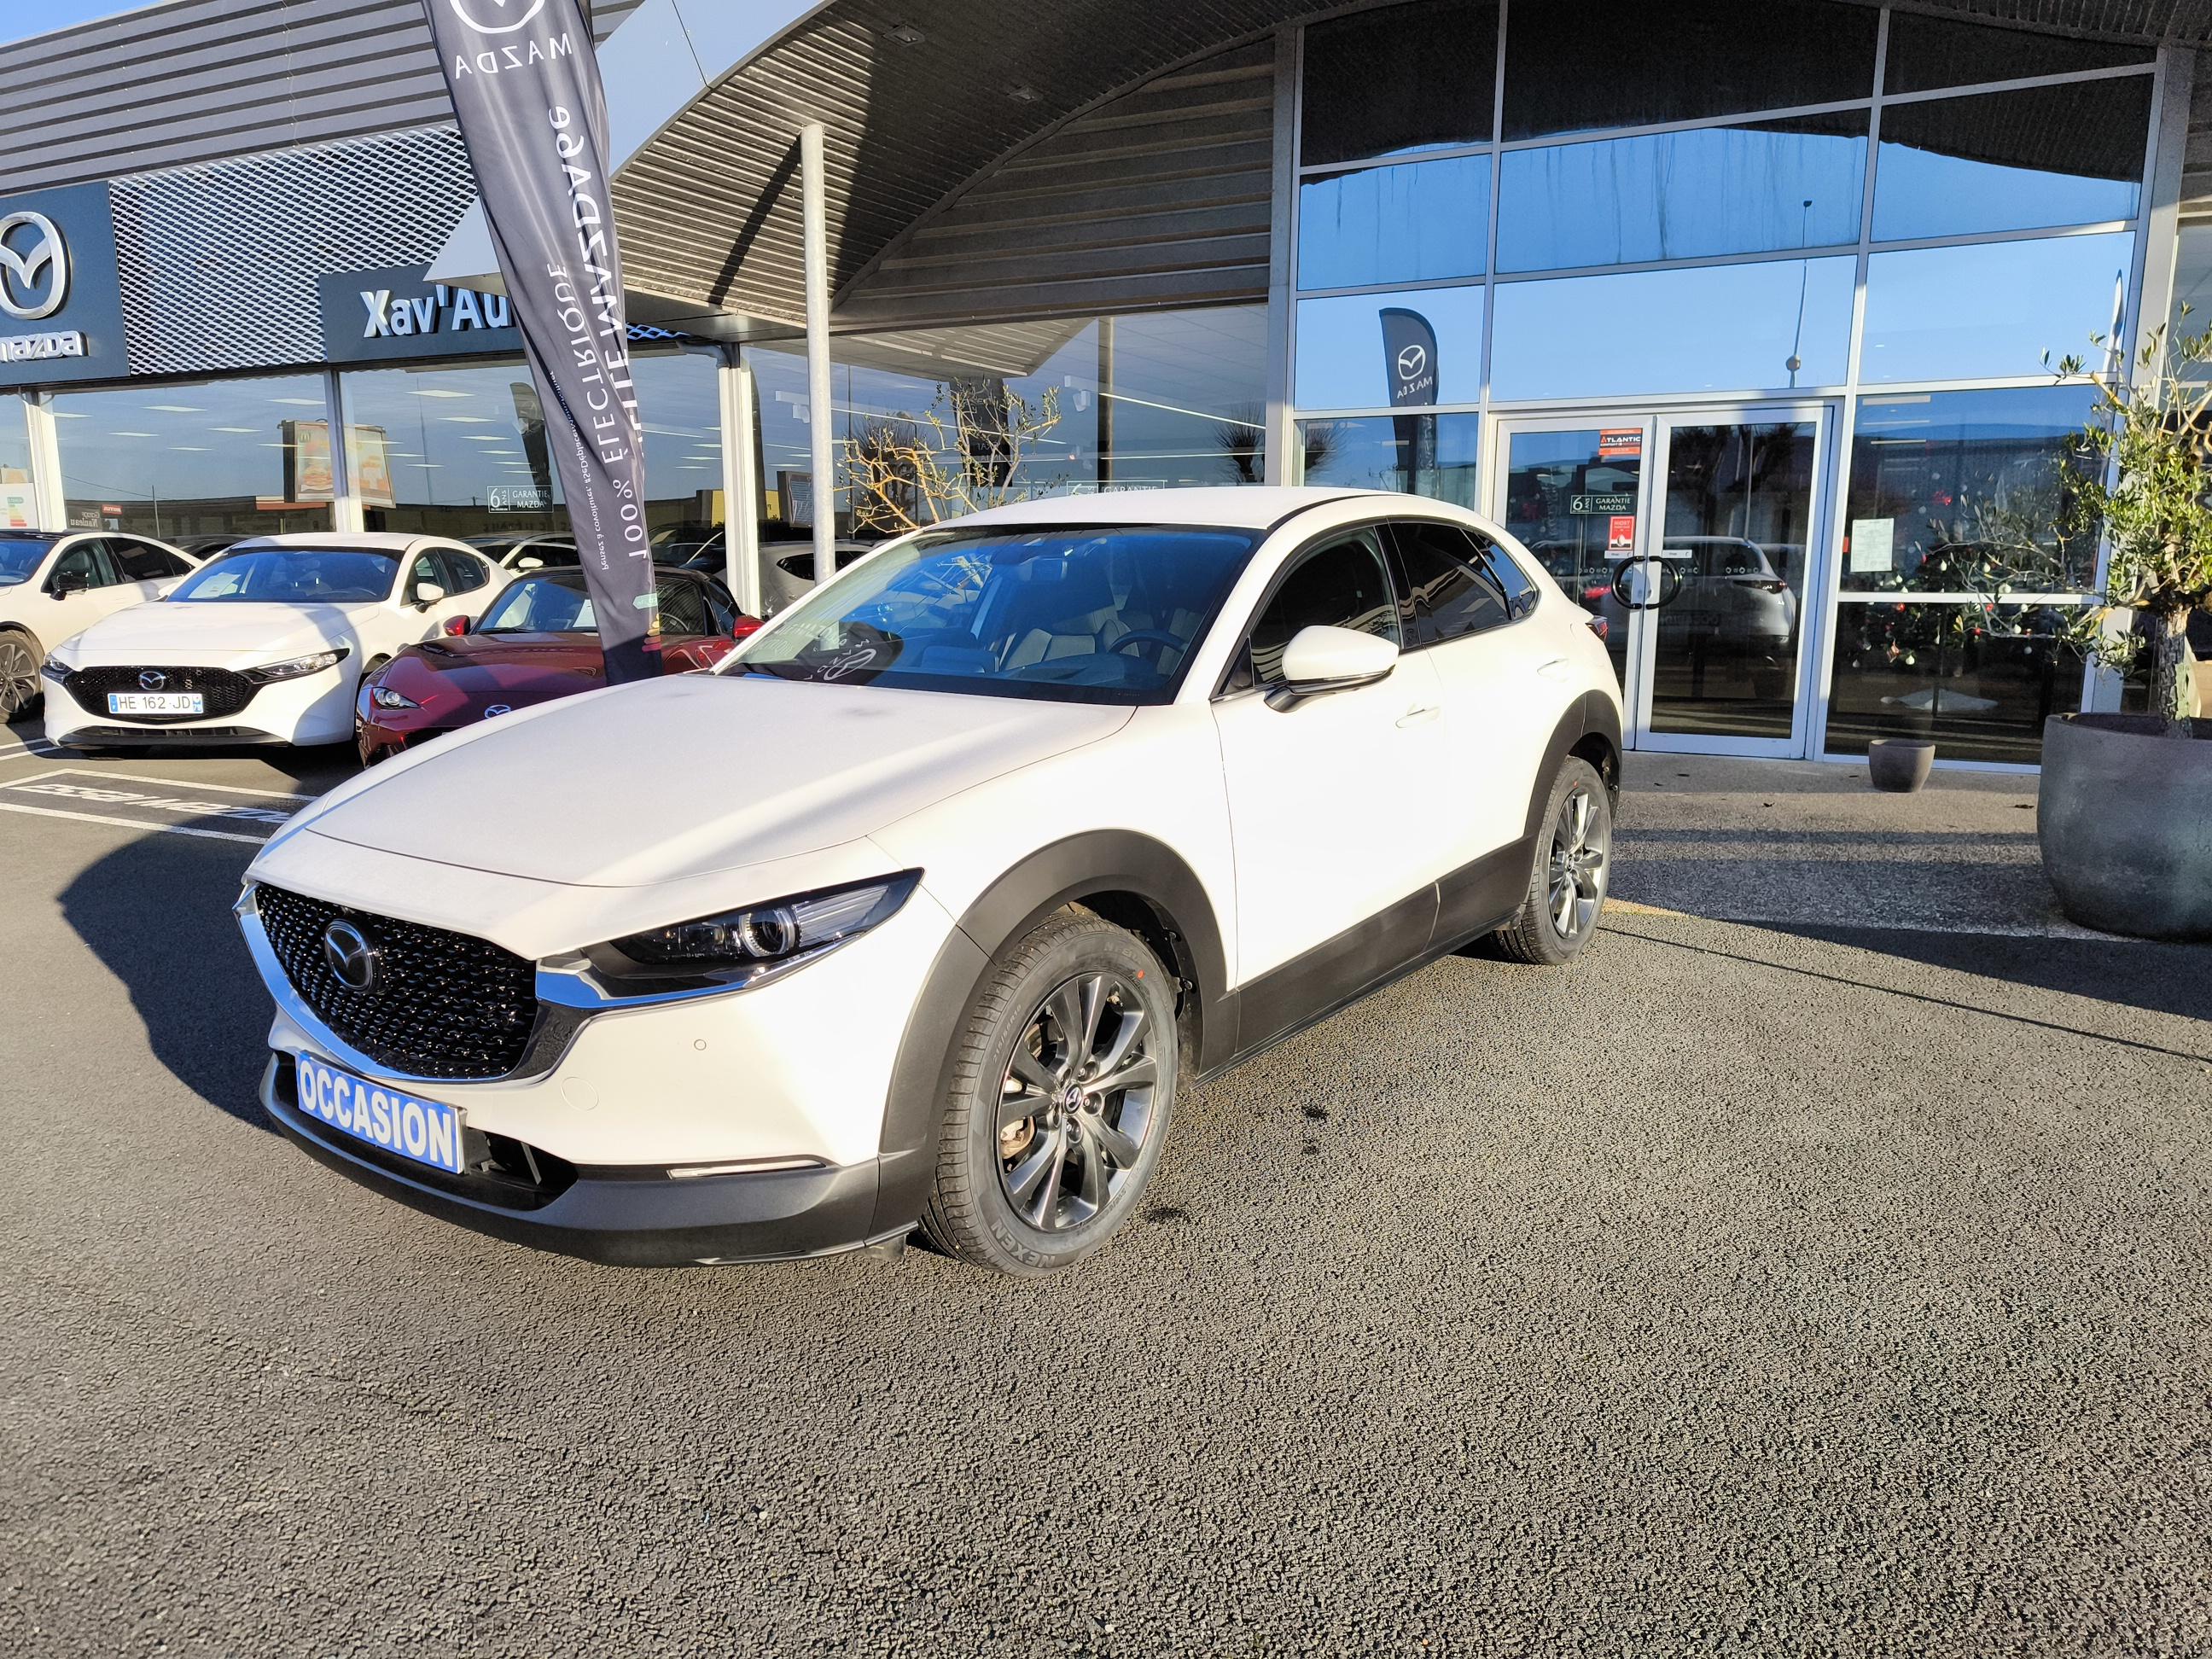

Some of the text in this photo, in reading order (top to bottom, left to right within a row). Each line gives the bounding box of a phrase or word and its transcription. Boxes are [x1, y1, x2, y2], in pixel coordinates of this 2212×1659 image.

[490, 487, 500, 508] 6
[1573, 496, 1583, 510] 6
[300, 1060, 453, 1167] OCCASION
[991, 1218, 1056, 1268] NEXEN
